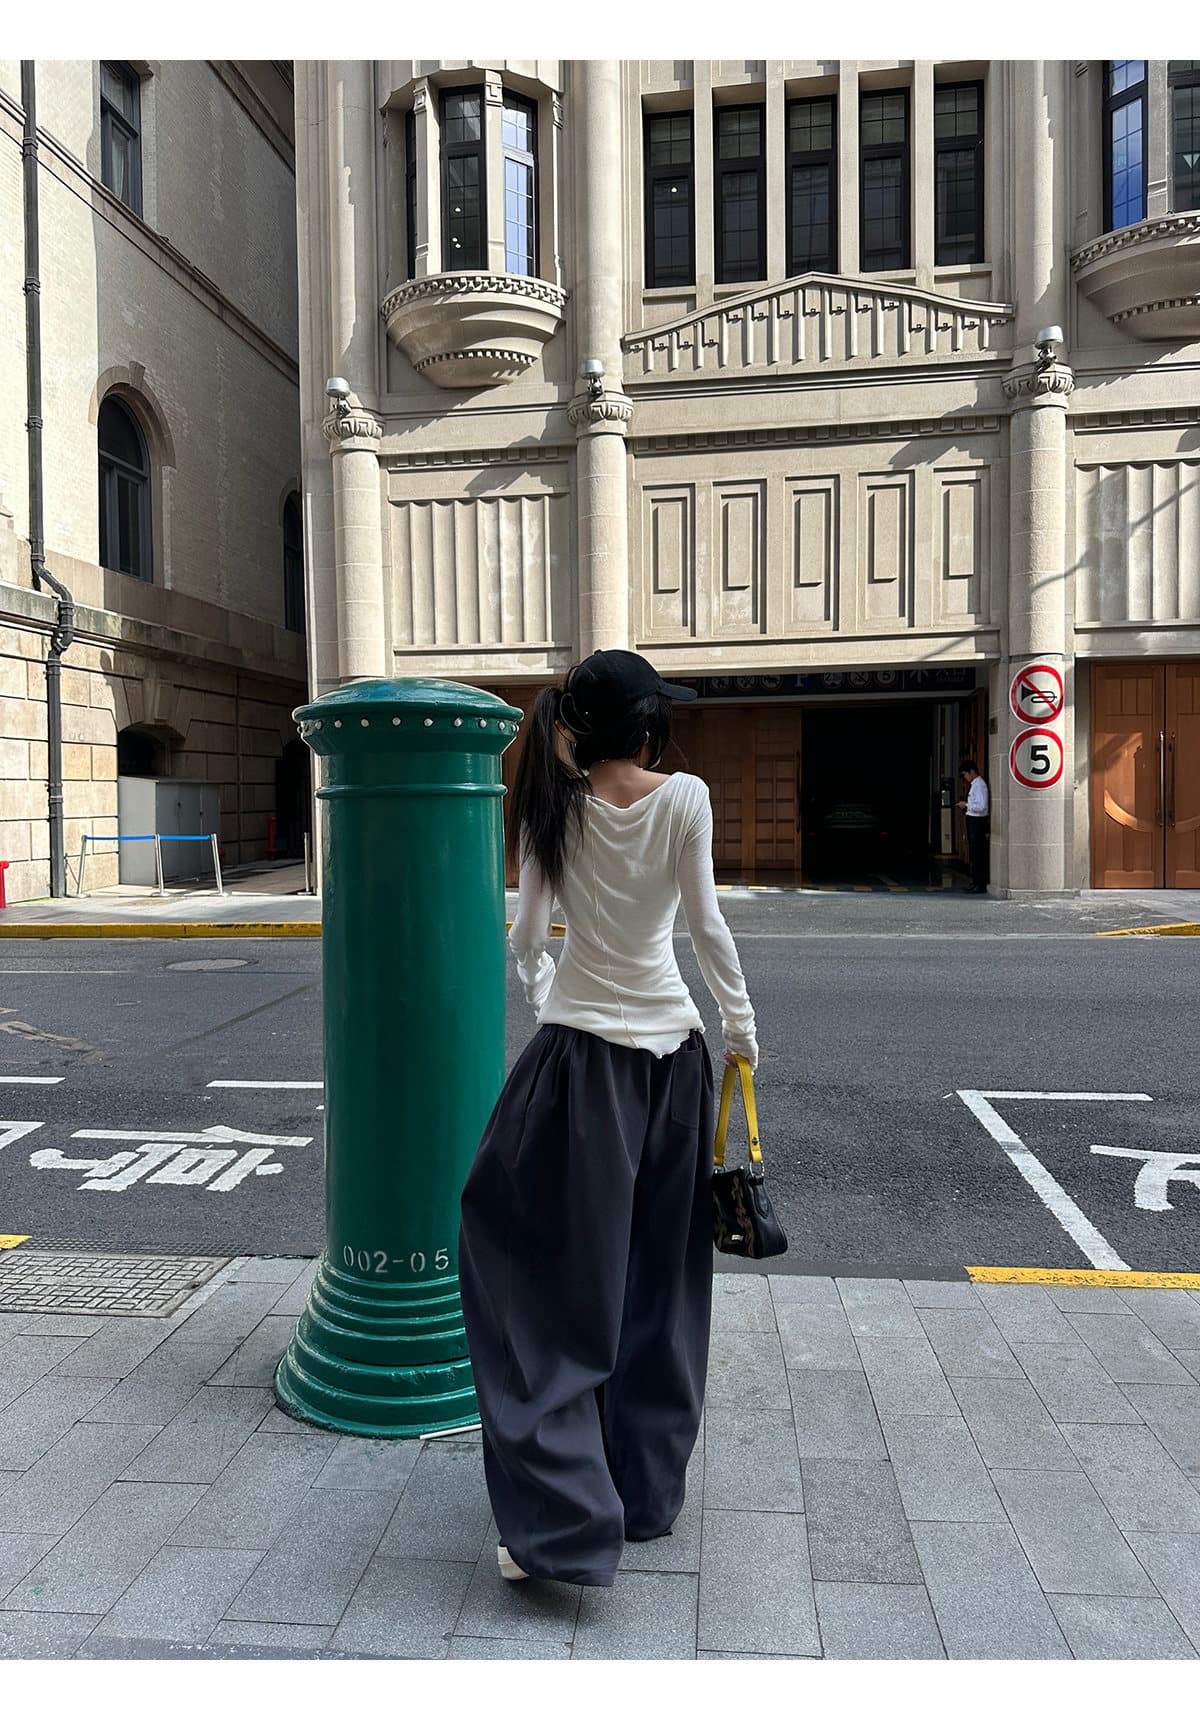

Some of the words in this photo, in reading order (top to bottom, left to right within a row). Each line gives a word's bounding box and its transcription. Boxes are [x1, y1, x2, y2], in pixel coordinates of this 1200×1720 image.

[1031, 745, 1050, 775] 5
[29, 1125, 314, 1192] 停
[343, 1245, 449, 1273] 002-05
